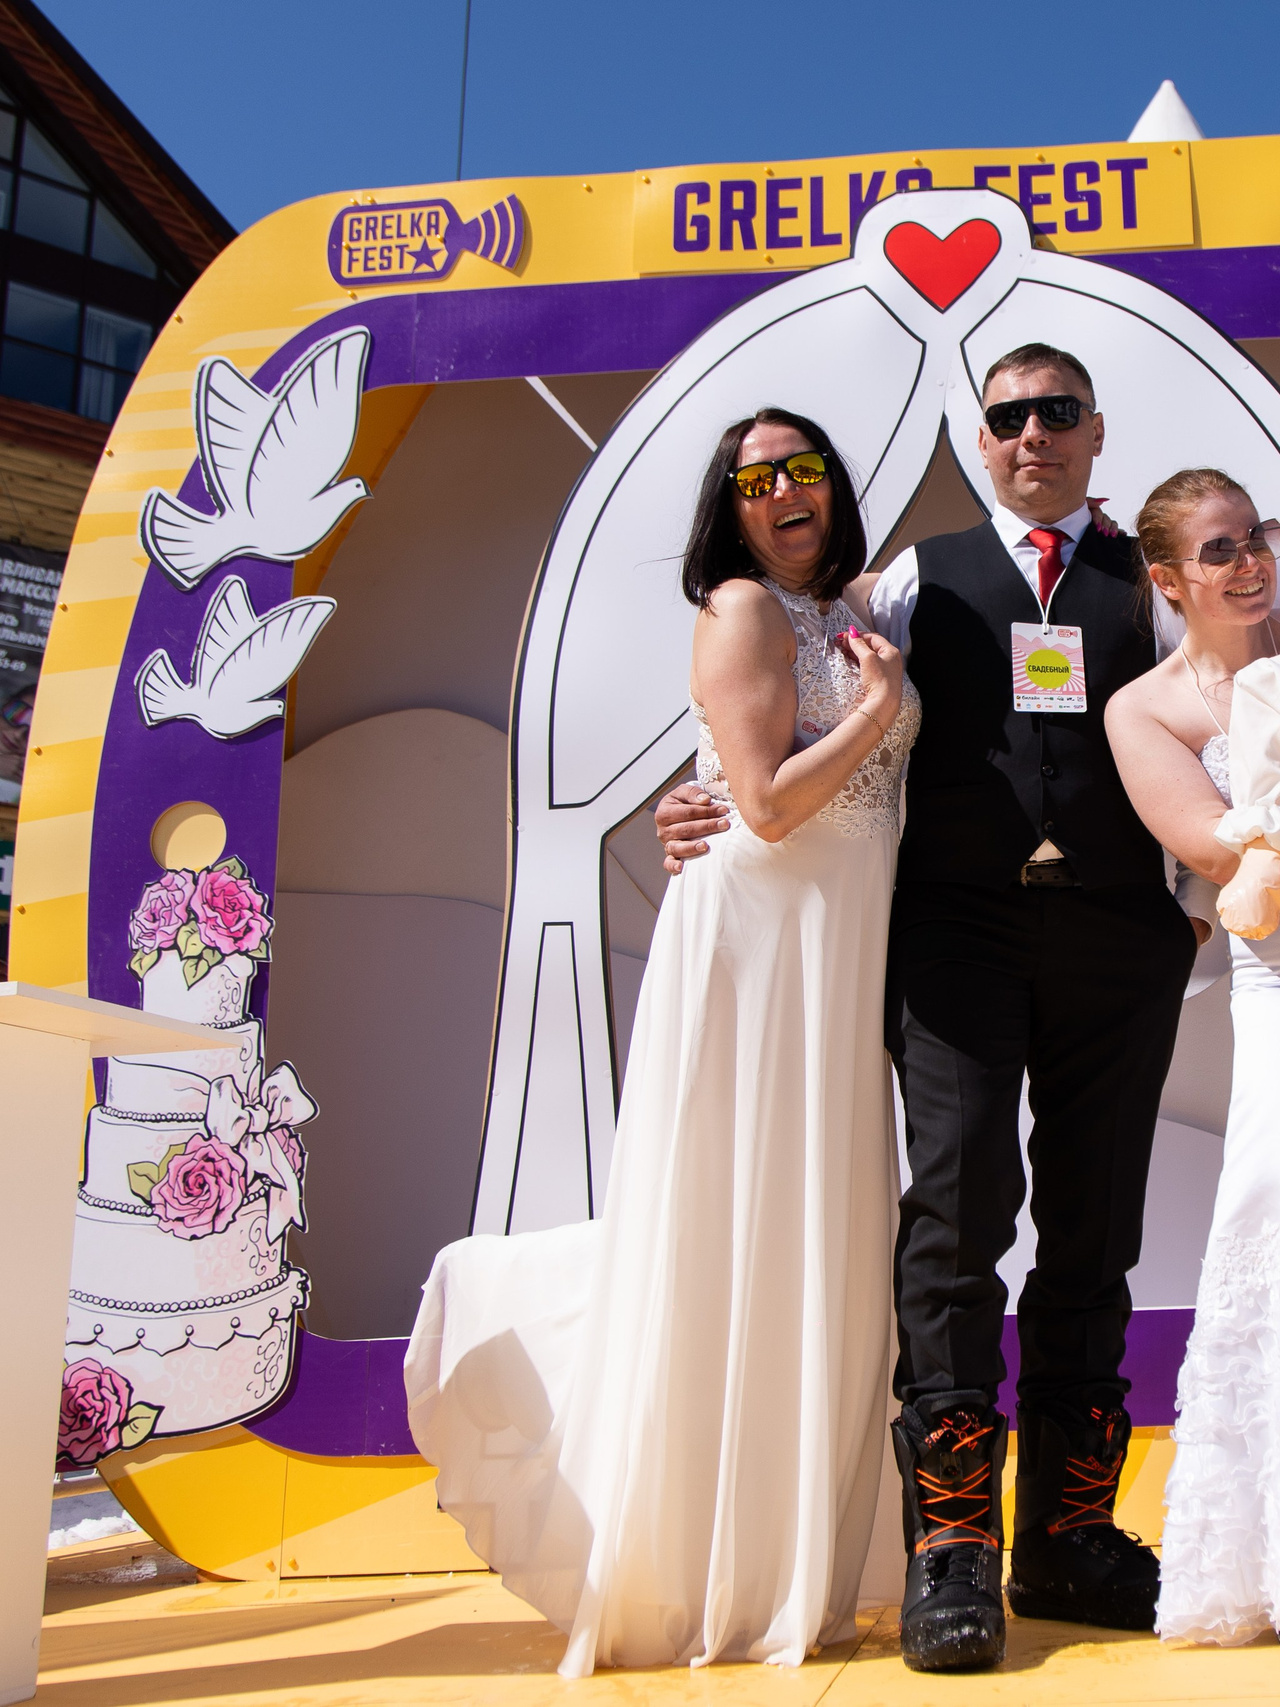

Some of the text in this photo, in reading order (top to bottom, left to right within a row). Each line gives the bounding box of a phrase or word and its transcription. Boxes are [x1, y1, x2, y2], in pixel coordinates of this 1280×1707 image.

[673, 168, 932, 253] GRELK
[349, 210, 440, 242] GRELKA
[347, 244, 410, 273] FEST
[1028, 664, 1070, 674] СВАДЕБНЫЙ
